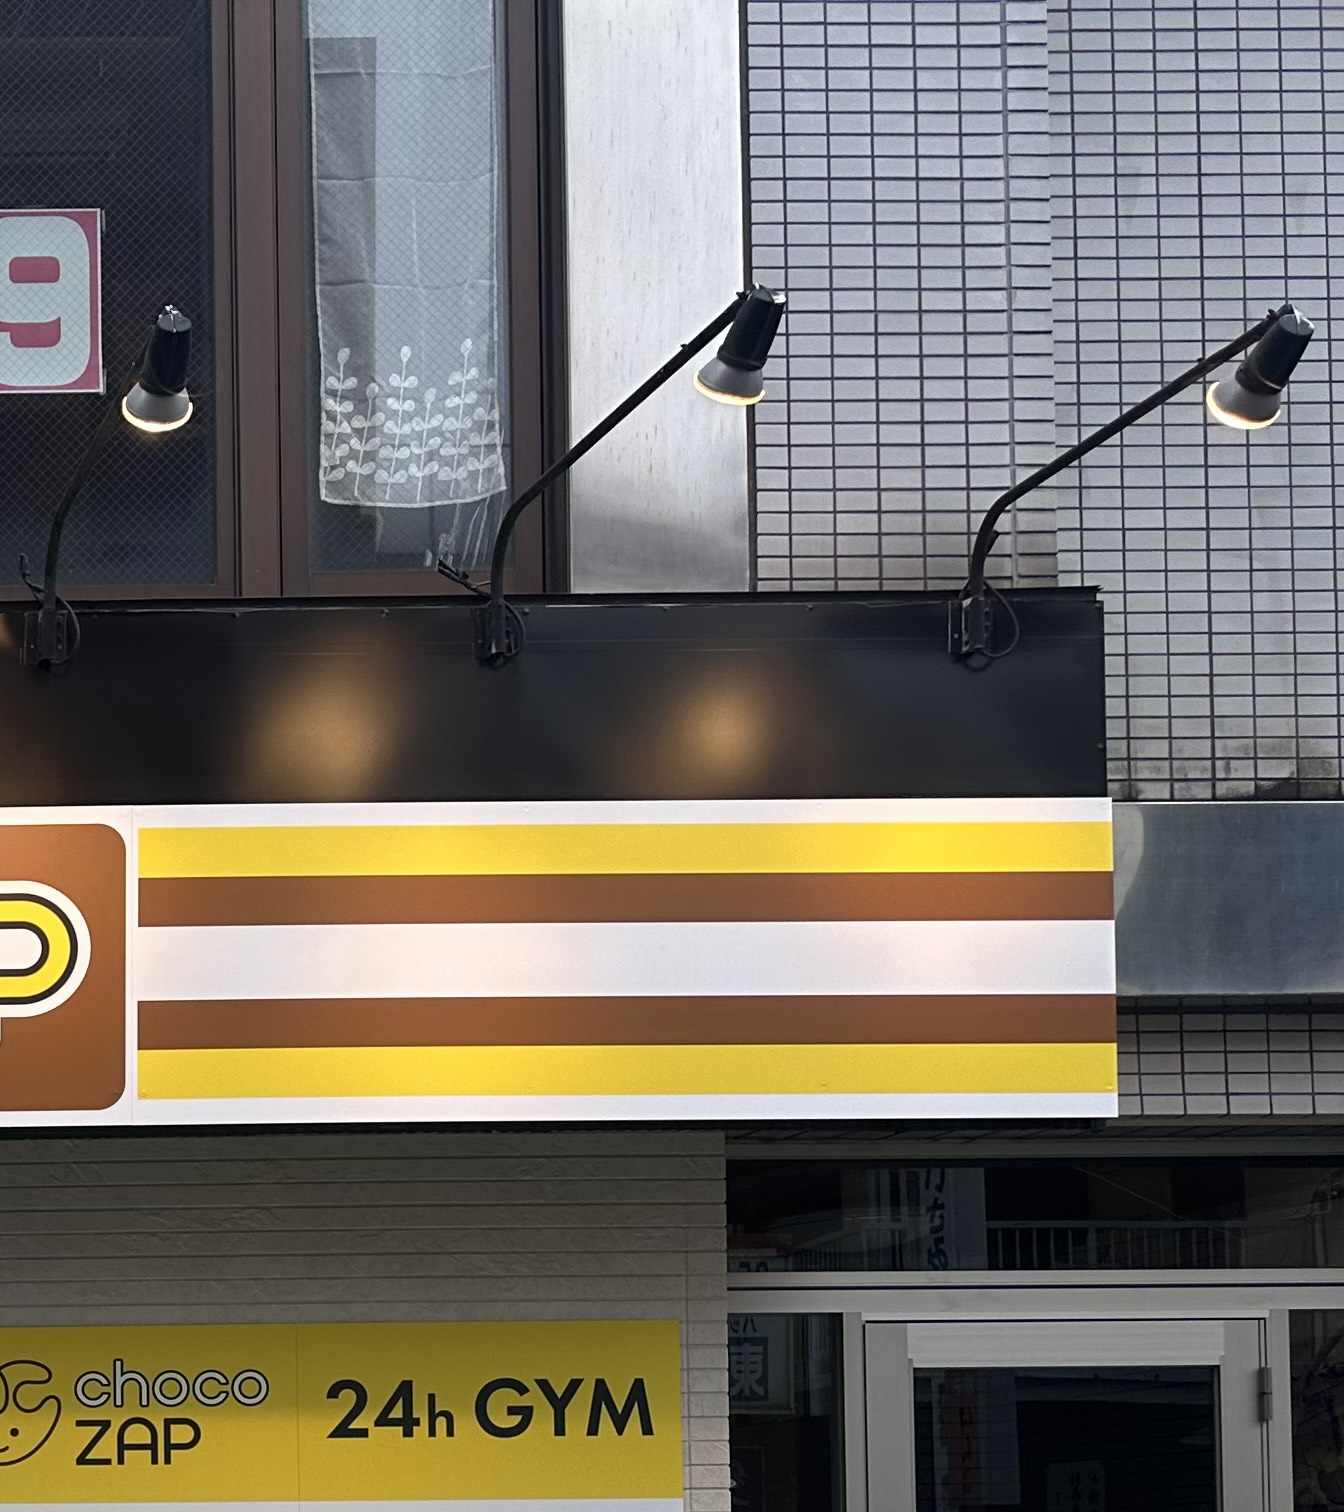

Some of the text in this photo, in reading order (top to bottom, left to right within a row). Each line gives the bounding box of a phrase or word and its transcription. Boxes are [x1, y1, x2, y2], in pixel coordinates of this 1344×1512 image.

[73, 1358, 270, 1409] choco
[324, 1377, 655, 1439] 24h GYM
[75, 1416, 202, 1466] ZAP
